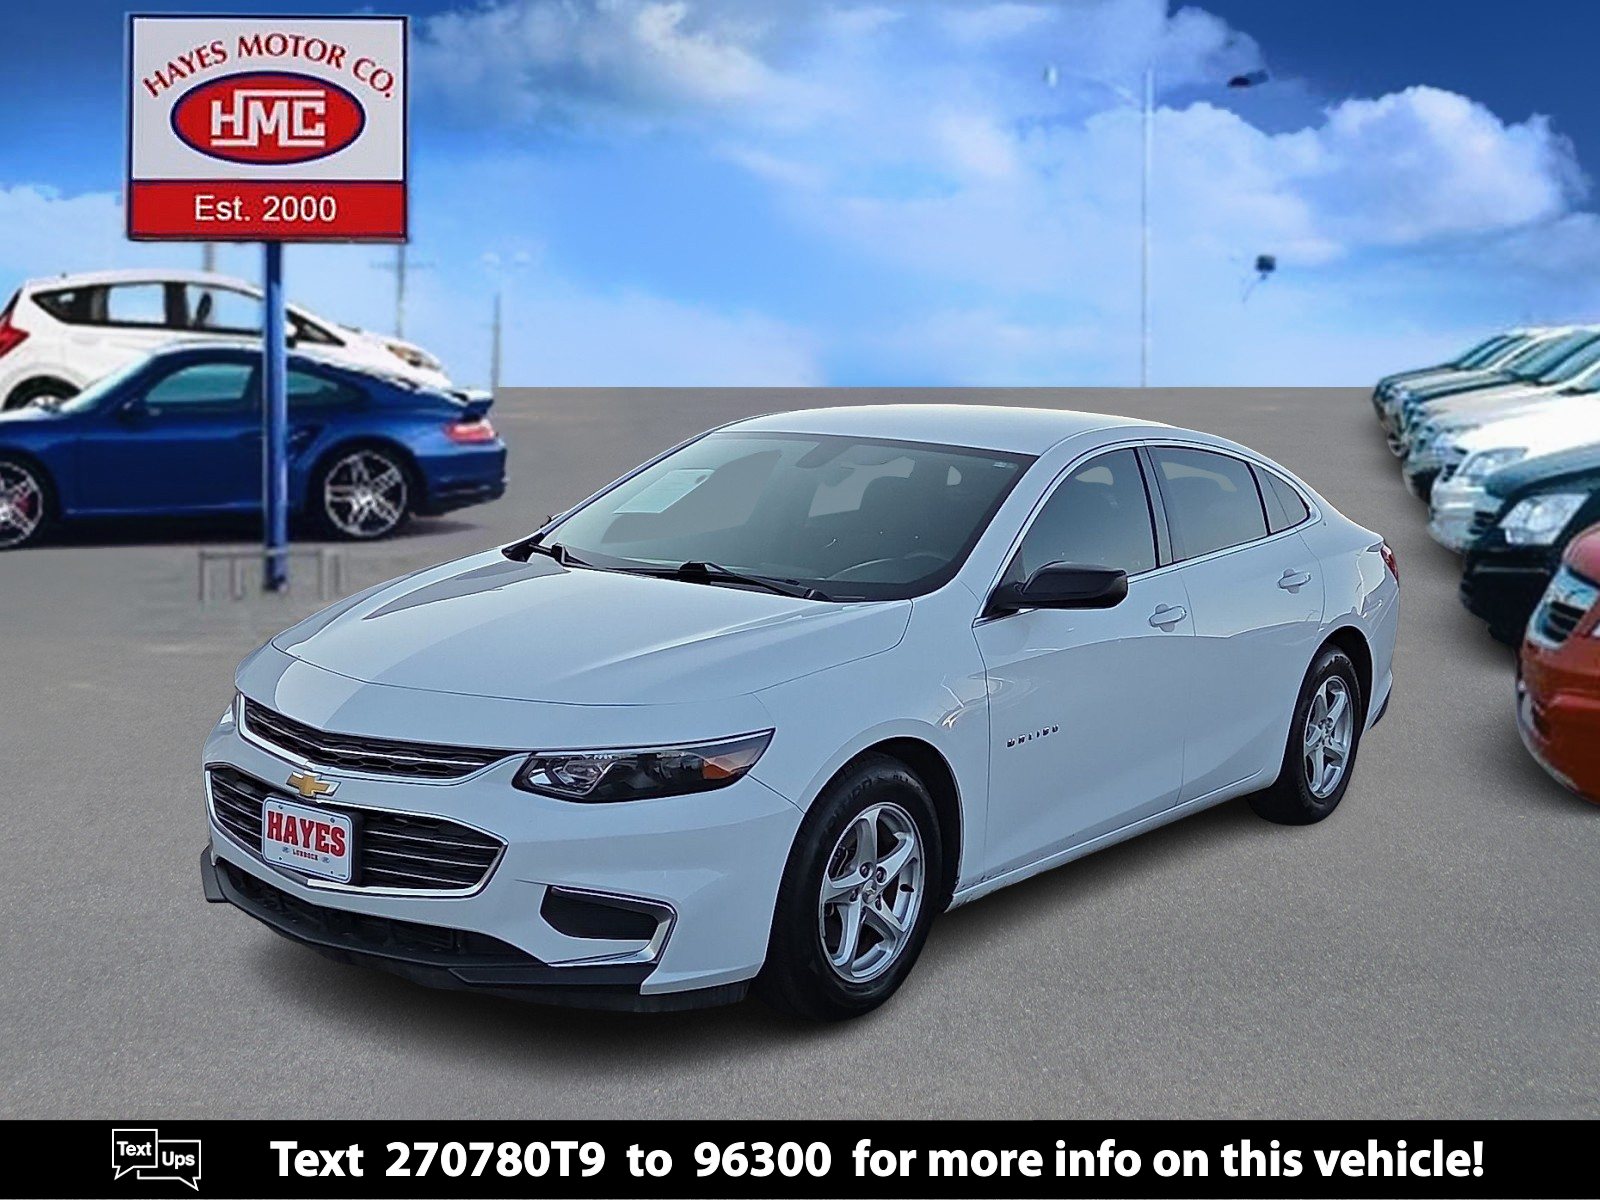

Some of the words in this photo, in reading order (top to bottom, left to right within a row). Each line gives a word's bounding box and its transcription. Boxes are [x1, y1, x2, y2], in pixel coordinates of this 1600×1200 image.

[142, 40, 228, 98] HAYES
[237, 33, 347, 70] MOTOR
[352, 57, 395, 98] CO.
[210, 89, 326, 147] HMC
[194, 194, 251, 222] Est.
[262, 195, 338, 223] 2000
[266, 810, 346, 858] HAYES
